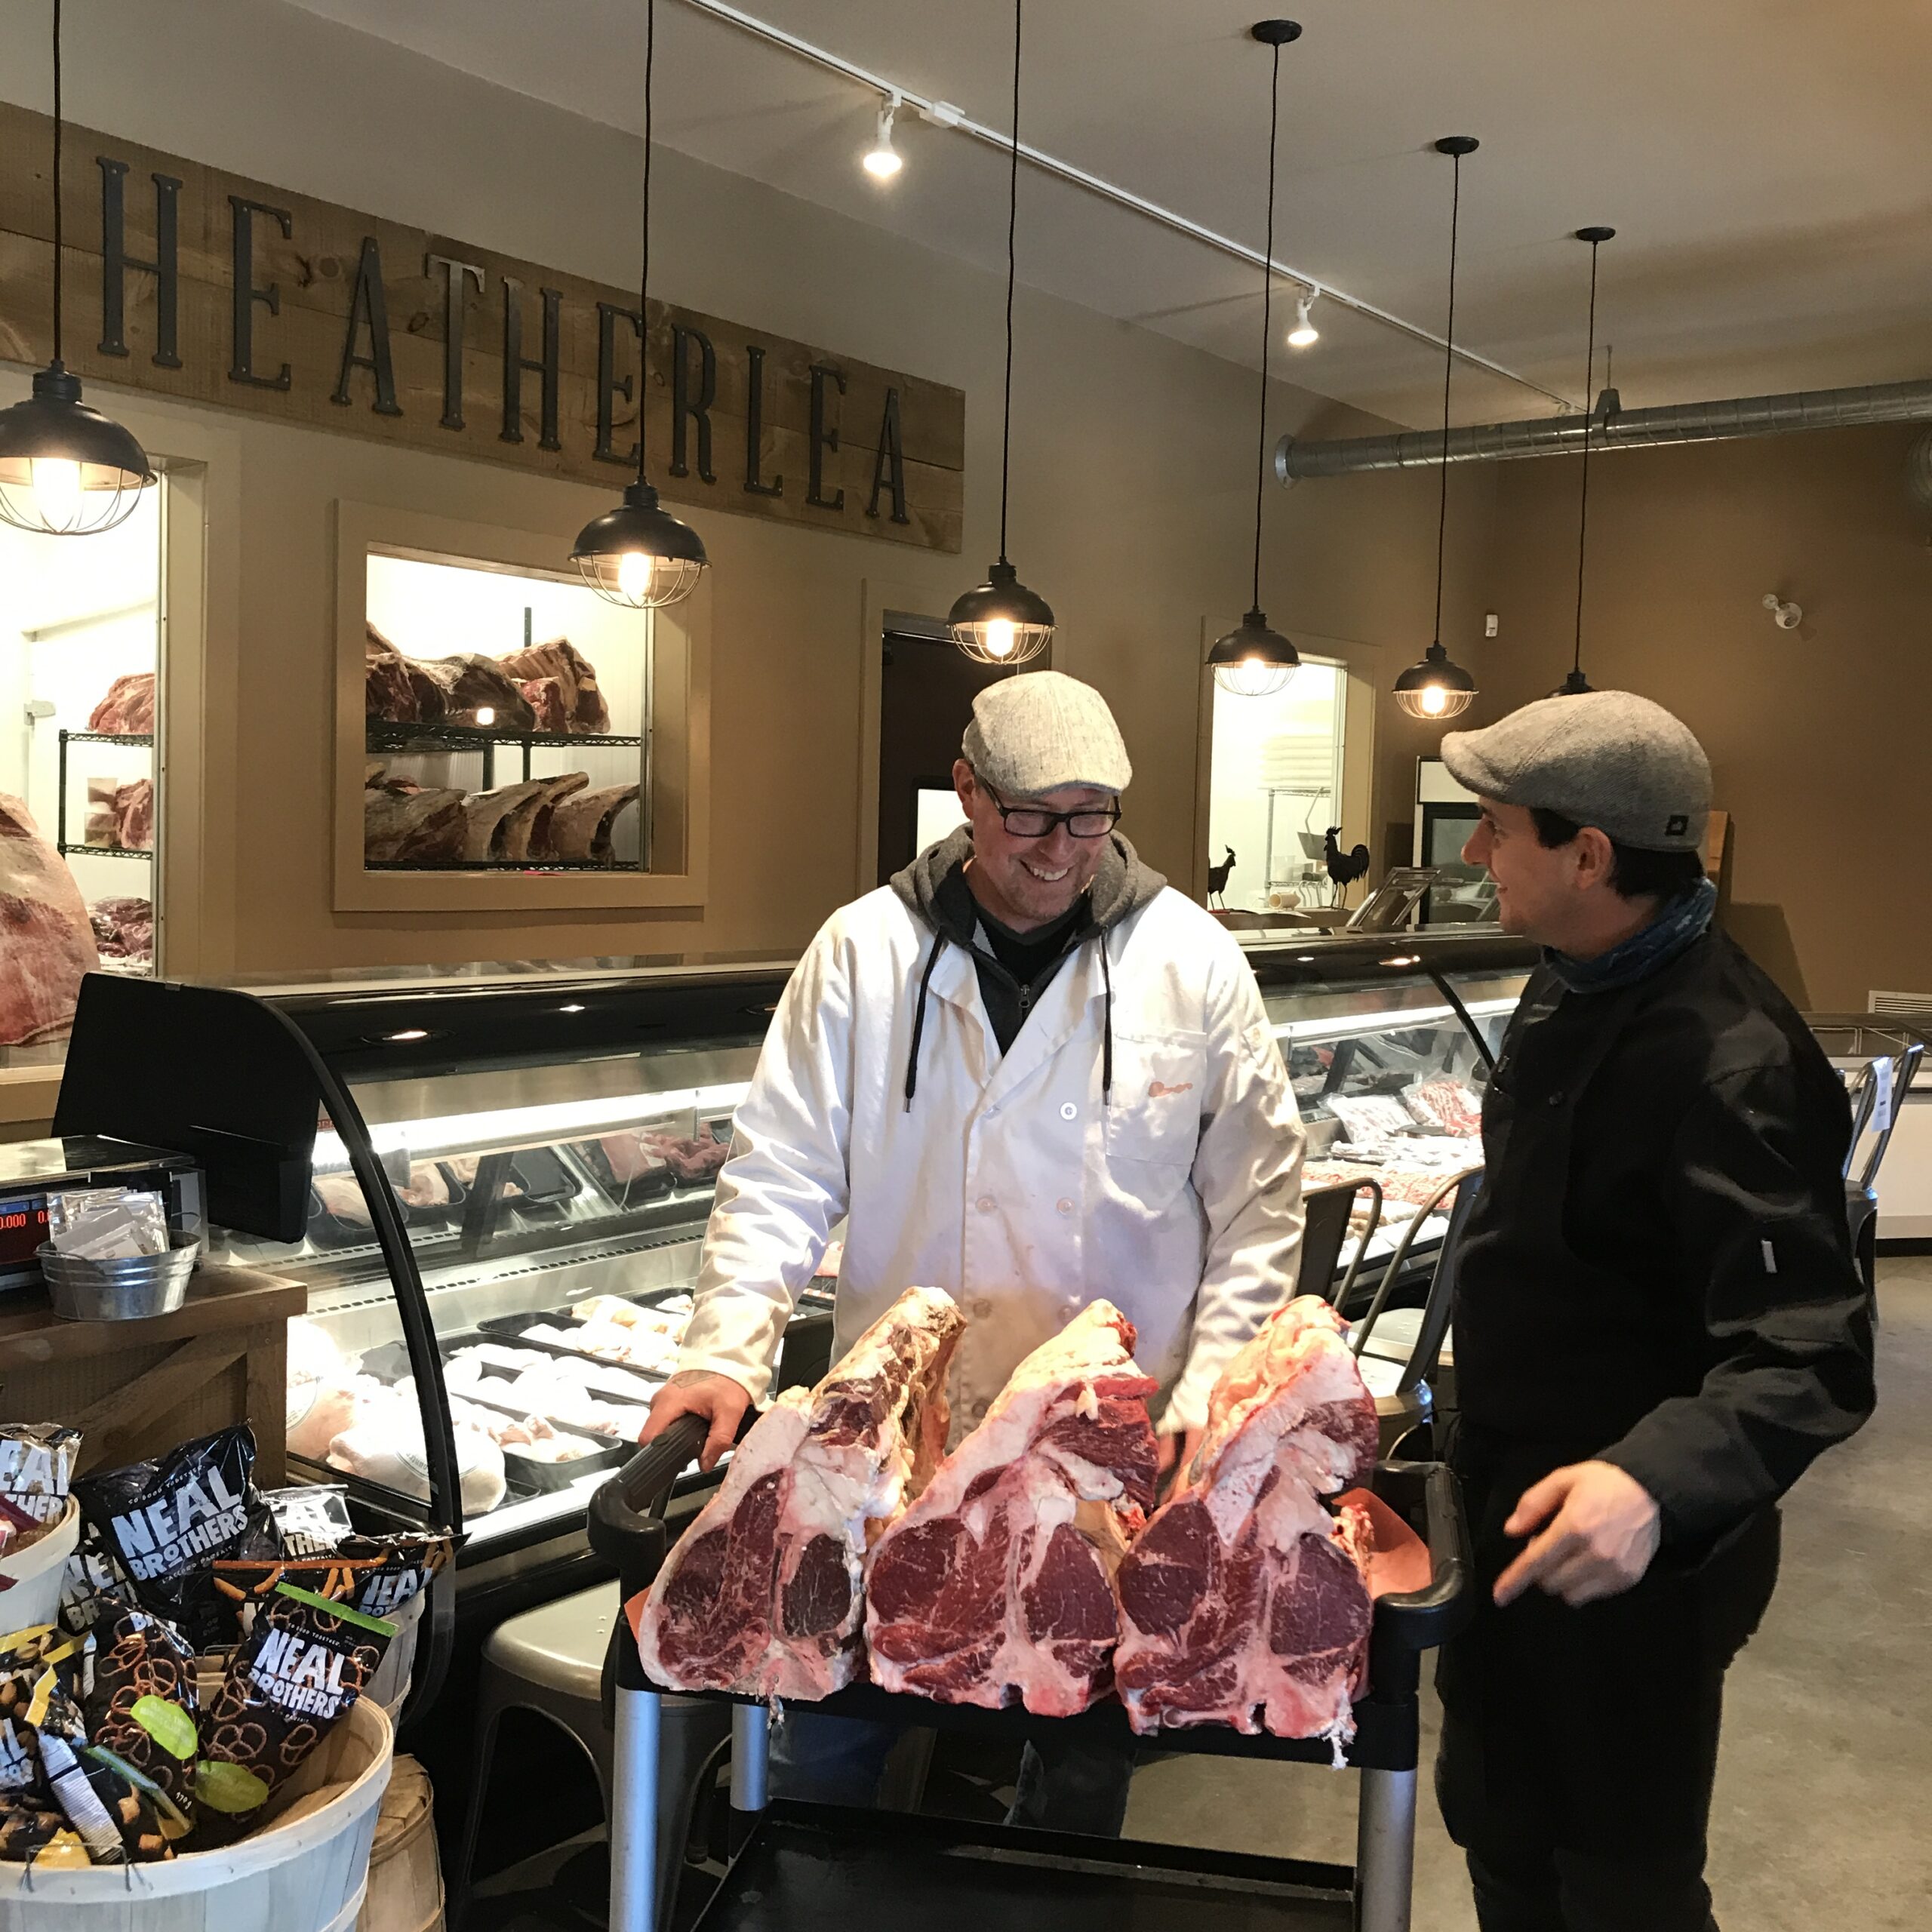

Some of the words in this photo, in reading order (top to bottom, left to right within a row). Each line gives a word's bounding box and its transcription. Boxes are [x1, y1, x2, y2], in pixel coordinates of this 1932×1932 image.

[97, 155, 910, 525] HEATHERLEA
[112, 1466, 242, 1558] NEAL
[128, 1506, 248, 1581] BROTHERS
[248, 1667, 341, 1718] BROTHERS
[254, 1628, 345, 1695] NEAL
